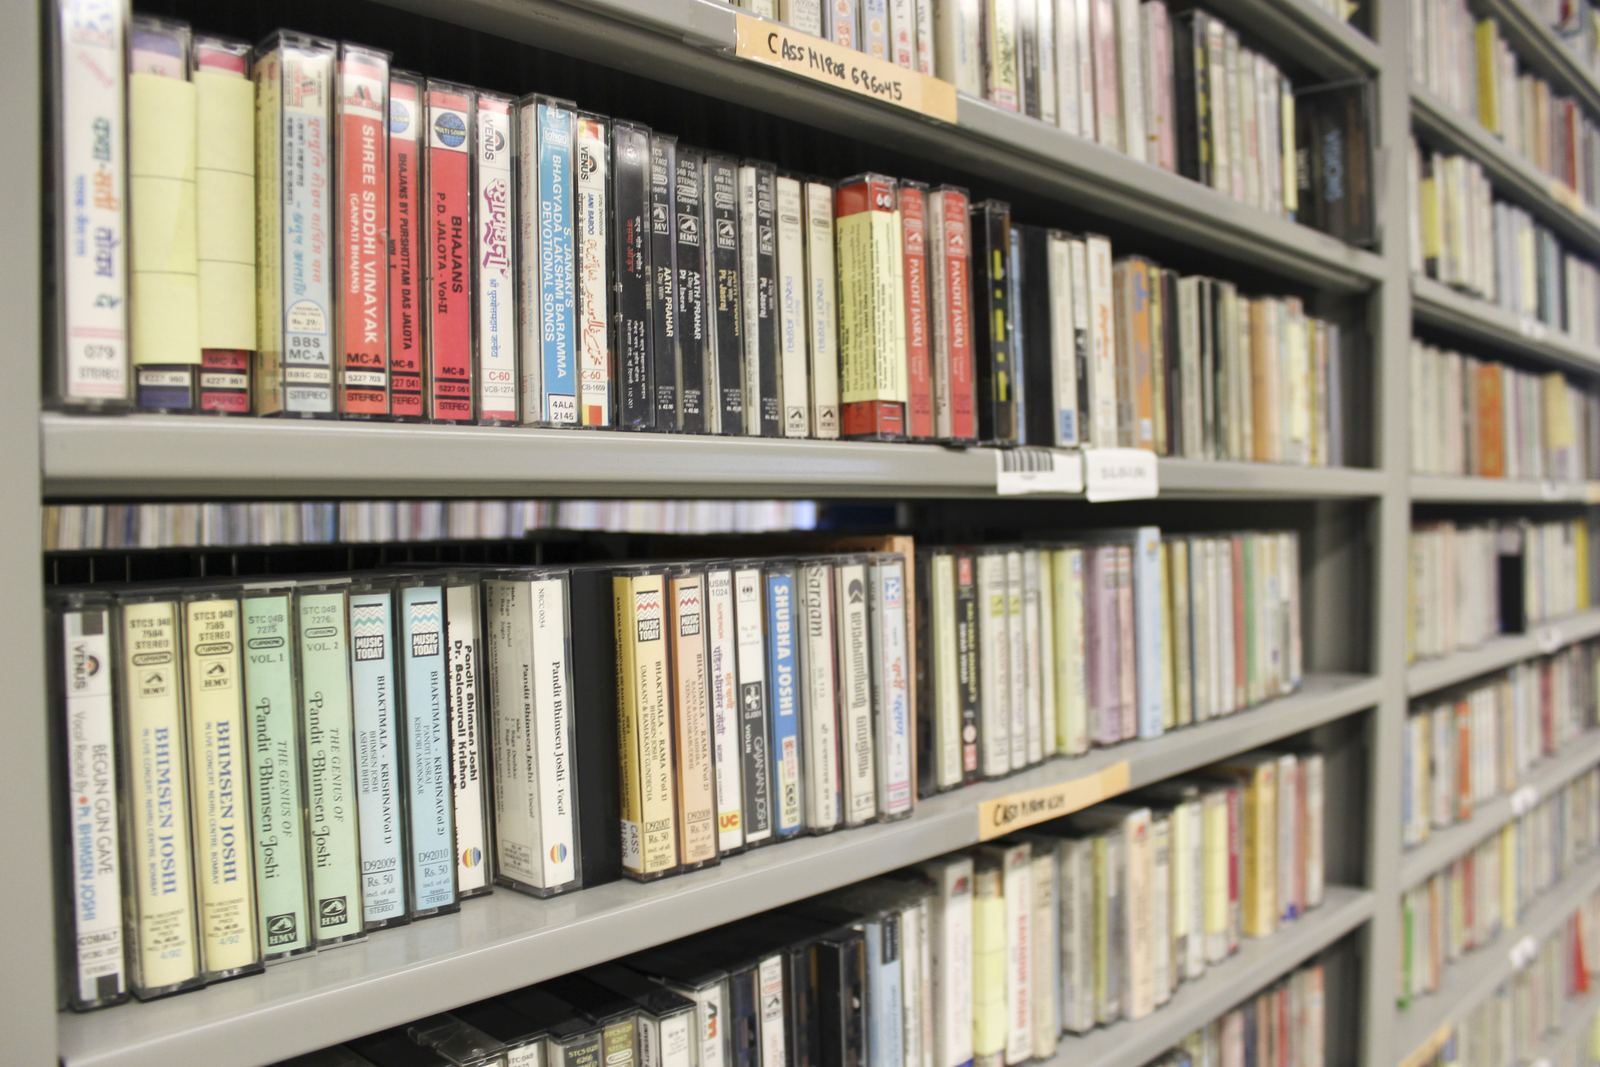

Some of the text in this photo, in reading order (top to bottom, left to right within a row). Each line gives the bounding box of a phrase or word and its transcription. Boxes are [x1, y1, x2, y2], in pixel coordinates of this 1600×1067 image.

[484, 117, 495, 161] VENUS
[580, 145, 589, 181] VENUS
[552, 154, 563, 232] BHAGYADA
[350, 192, 360, 294] (GANPATI BHAJANS)
[362, 124, 379, 343] SHREE SIDDHI VINAYAK
[398, 152, 412, 350] BHAJANS BY PURSHOTTAM DAS JALOTA
[437, 220, 447, 271] JALOTA
[679, 232, 698, 243] HMV
[451, 215, 463, 293] BHAJANS
[542, 201, 555, 342] DEVOTIONAL SONGS
[554, 237, 564, 299] LAKSHMI
[563, 227, 573, 308] S. JANAKI'S
[719, 282, 728, 312] Jasraj
[909, 258, 921, 306] PANDIT
[663, 266, 674, 338] AATH PRAHAR
[693, 271, 702, 341] AATH PRAHAR
[759, 291, 768, 318] Jasraj
[951, 260, 965, 348] PANDIT JASRAJ
[291, 336, 321, 349] BBS
[555, 303, 567, 378] BARAMMA
[911, 307, 923, 348] JASRAJ
[288, 349, 326, 362] MC-A
[346, 353, 382, 364] MC-A
[488, 370, 510, 381] C-60
[288, 390, 329, 402] STEREO
[347, 392, 384, 403] STEREO
[439, 401, 470, 411] STEREO
[552, 400, 574, 409] 4ALA
[708, 579, 730, 588] USBM
[711, 587, 728, 596] 1024
[801, 561, 824, 638] Sargam
[248, 615, 267, 624] STC
[302, 606, 321, 615] STC
[638, 620, 659, 630] MUSIC
[681, 615, 699, 625] MUSIC
[135, 639, 169, 649] STEREO
[198, 631, 231, 641] STEREO
[306, 641, 339, 652] VOL. 2
[356, 636, 383, 648] MUSIC
[413, 633, 438, 646] MUSIC
[639, 630, 660, 641] TODAY
[681, 625, 700, 636] TODAY
[73, 644, 87, 690] VENUS
[250, 653, 284, 664] VOL. 1
[356, 648, 384, 661] TODAY
[413, 645, 439, 657] TODAY
[454, 640, 463, 660] Dr.
[774, 585, 793, 716] SHUBHA JOSHI
[376, 675, 388, 750] BHAKTIMALA
[430, 670, 441, 744] BHAKTIMALA
[454, 663, 466, 737] Balamurali
[464, 645, 477, 781] Pandit Bhimsen Joshi
[655, 660, 668, 770] BHAKTIMALA RAMA
[696, 653, 708, 759] BHAKTIMALA RAMA
[522, 663, 534, 783] Pandit Bhimsen Joshi
[552, 661, 566, 815] Pandit Bhimsen Joshi Vocal
[640, 664, 653, 802] UMAKANT RAMAKANT GUNDECHA
[744, 724, 752, 753] VIOLIN
[360, 730, 369, 795] ASHWINI BHIDE
[369, 730, 378, 792] BHIMSEN JOSHI
[414, 716, 425, 795] KISHORI AMONKAR
[423, 725, 432, 785] PANDIT JASRAJ
[457, 740, 466, 789] Krishna
[154, 727, 174, 828] BHIMSEN
[255, 697, 281, 880] Pandit Bhimsen Joshi
[278, 740, 293, 838] THE GENIUS OF
[308, 691, 333, 868] Pandit Bhimsen Joshi
[329, 727, 345, 822] THE GENIUS OF
[753, 736, 767, 830] GAJANAN JOSHI
[72, 710, 97, 921] Vocal BHIMSEN JOSHI
[92, 744, 112, 875] BEGUN GUN GAVE
[216, 721, 237, 883] BHIMSEN JOSHI
[648, 832, 669, 844] Rs. 50
[703, 823, 710, 832] 50
[720, 814, 739, 828] UC
[418, 849, 449, 863] D92010
[629, 824, 640, 855] CASS
[148, 862, 158, 896] BOMBAY
[160, 835, 176, 894] JOSHI
[210, 851, 220, 885] BOMBAY
[363, 857, 396, 872] D92009
[367, 875, 393, 887] Rs. 50
[424, 866, 448, 878] Rs. 50
[367, 904, 394, 914] STEREO
[425, 895, 449, 905] STEREO
[321, 914, 348, 926] HMV
[268, 932, 297, 945] HMV
